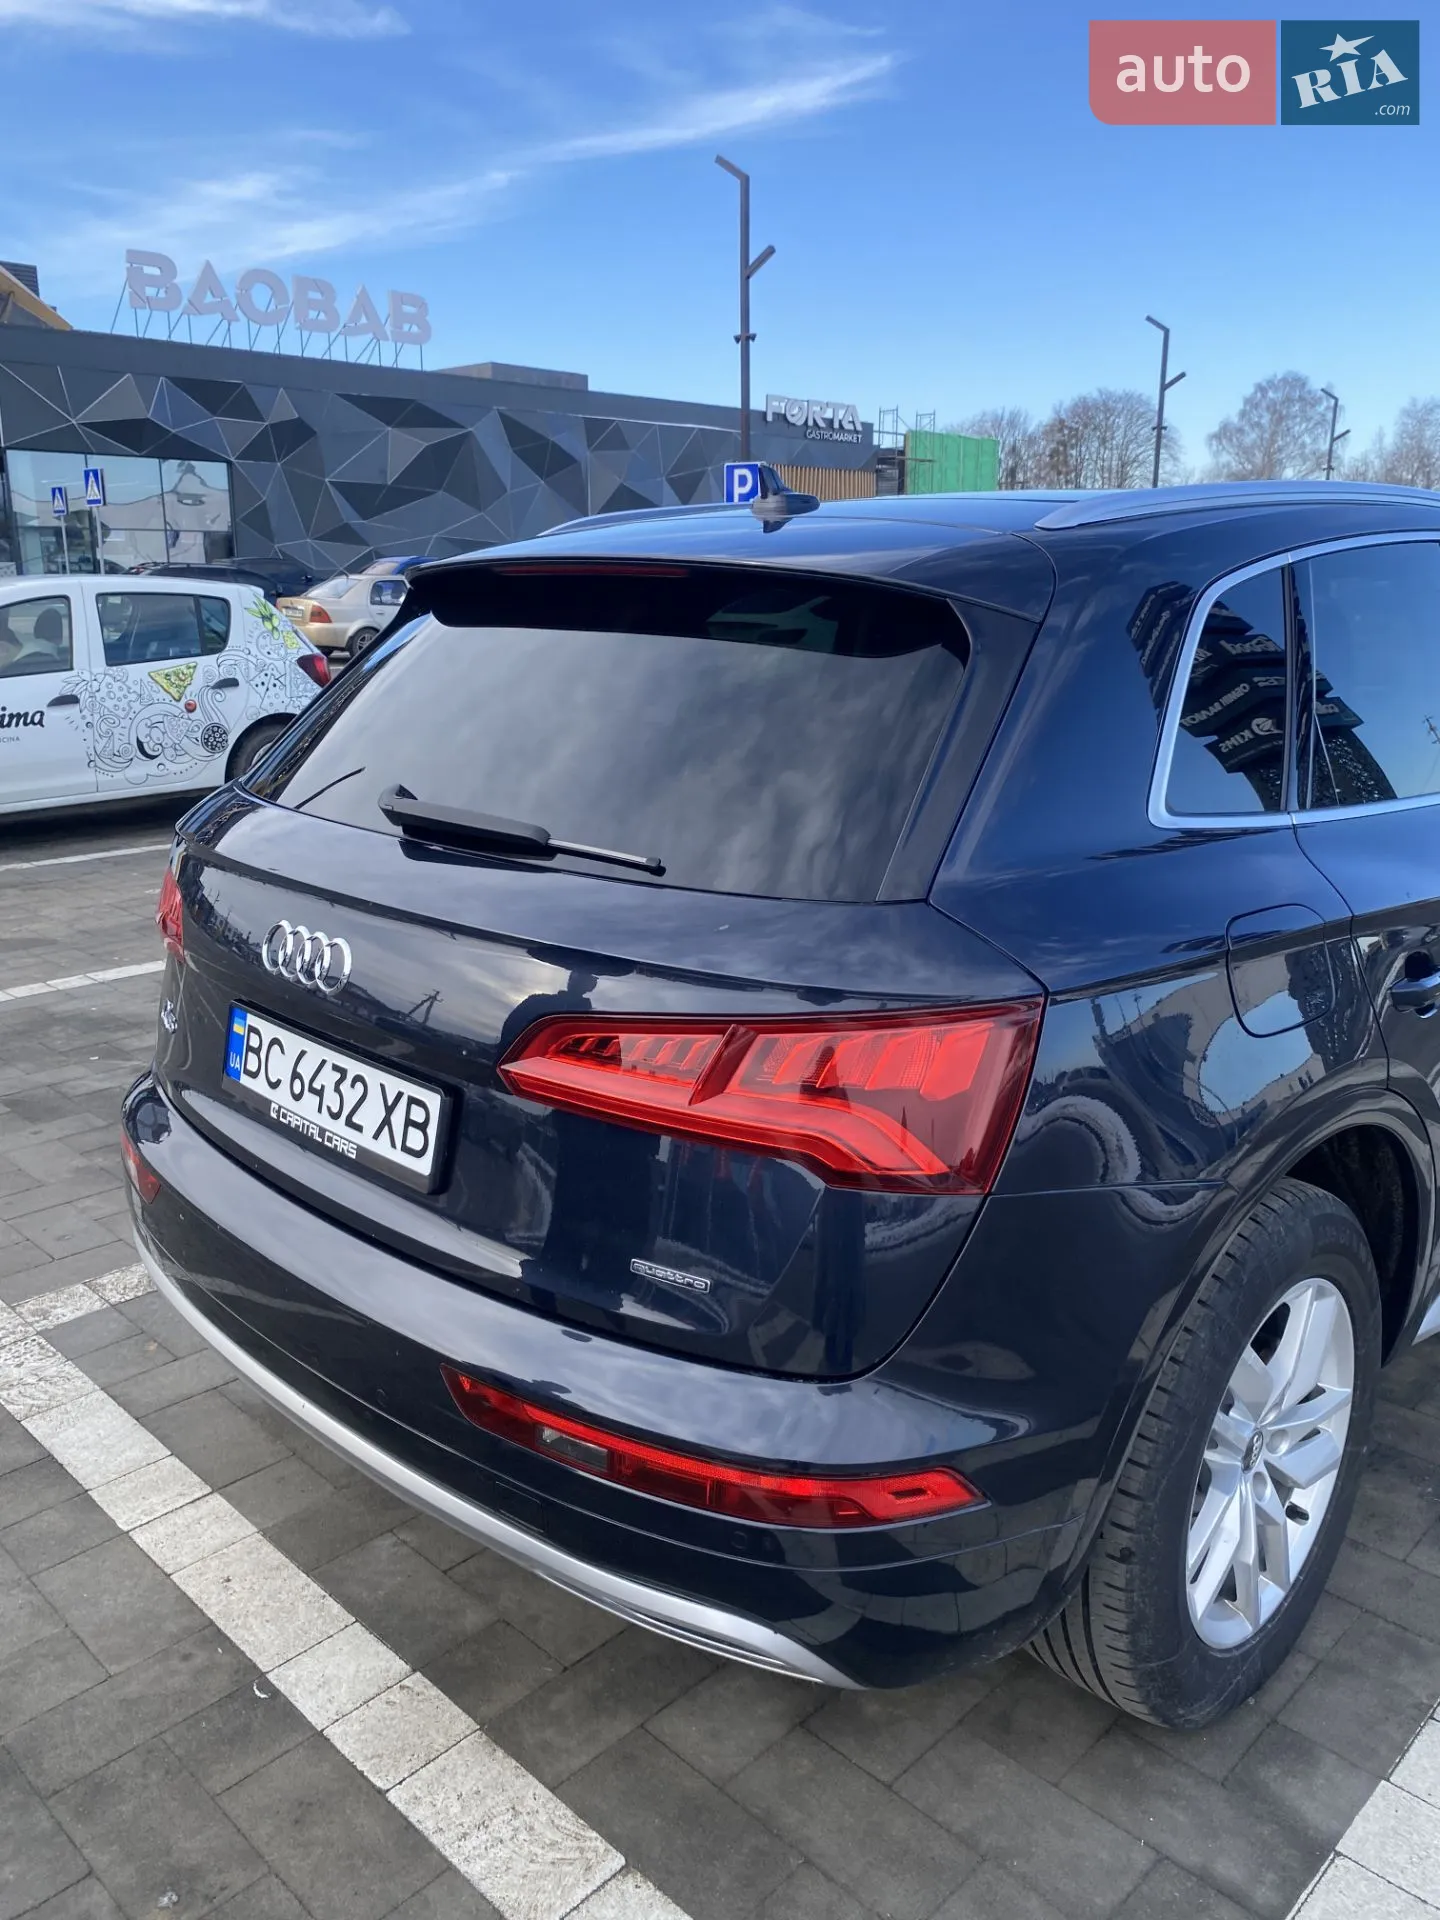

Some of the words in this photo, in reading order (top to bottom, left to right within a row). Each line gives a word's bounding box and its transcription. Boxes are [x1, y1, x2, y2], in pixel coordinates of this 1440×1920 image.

[126, 249, 432, 345] BAOBAB
[765, 394, 863, 431] FORTA
[806, 429, 862, 444] GASTROMARKET
[733, 468, 753, 502] P
[0, 736, 20, 744] CINA
[229, 1051, 241, 1071] UA
[279, 1108, 322, 1142] CAPITAL
[324, 1131, 357, 1159] CARS
[633, 1262, 706, 1289] quattro
